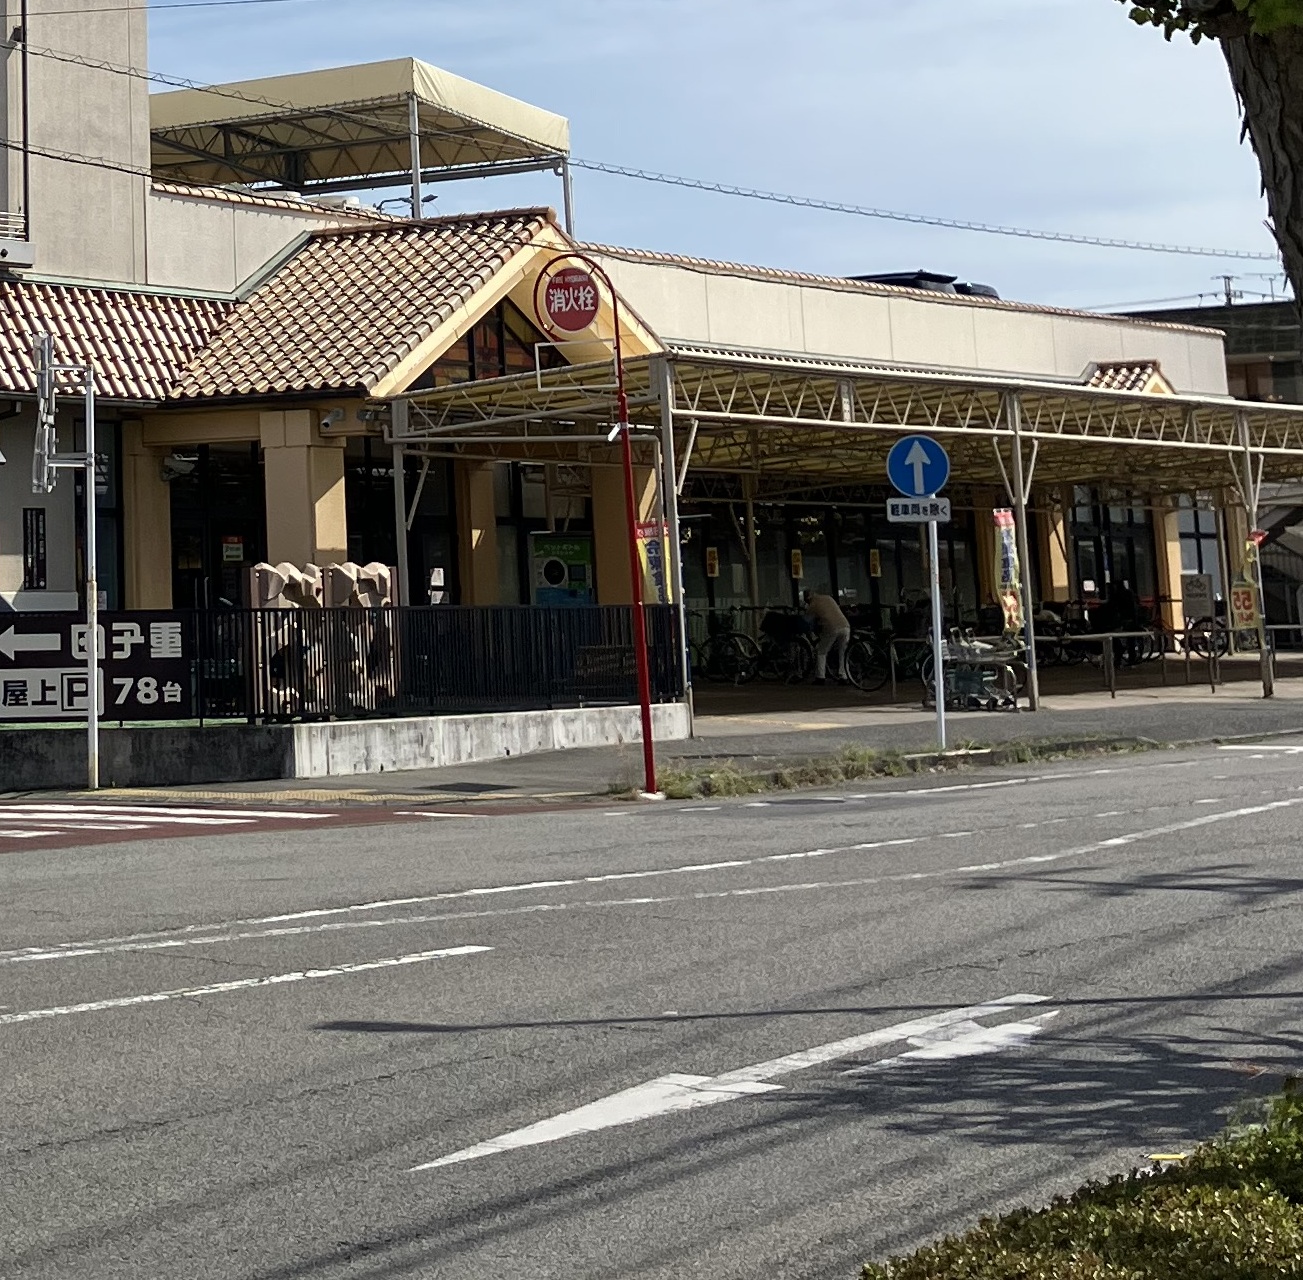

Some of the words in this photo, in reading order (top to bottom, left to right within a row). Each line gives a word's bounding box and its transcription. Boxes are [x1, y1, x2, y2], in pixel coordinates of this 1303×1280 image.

[548, 285, 596, 313] 消火栓
[112, 677, 183, 705] 78台
